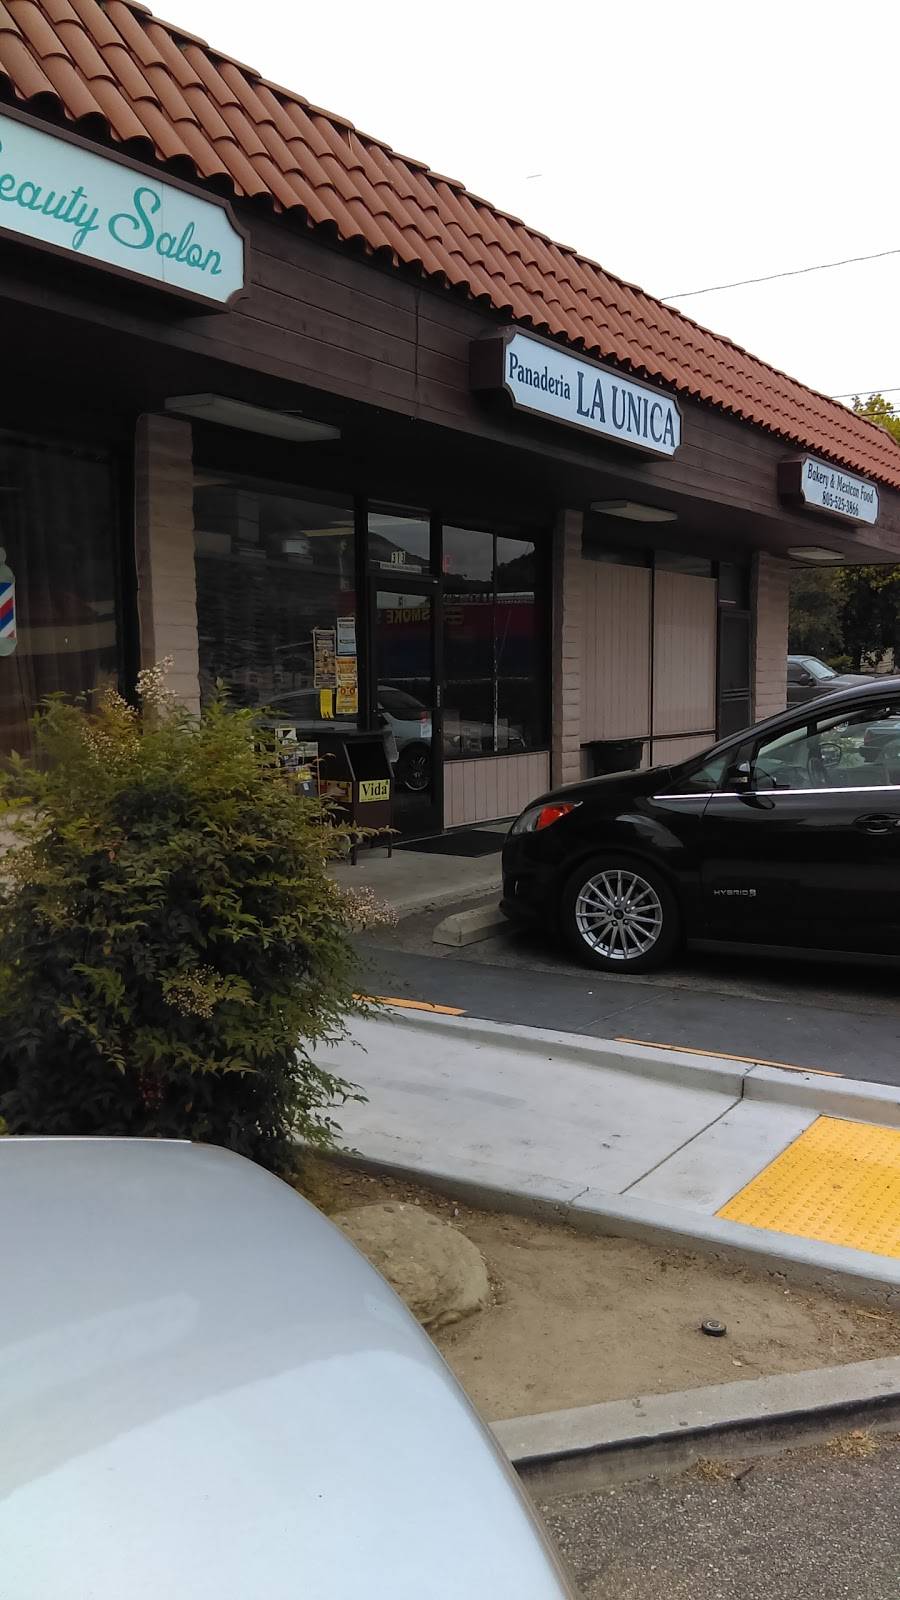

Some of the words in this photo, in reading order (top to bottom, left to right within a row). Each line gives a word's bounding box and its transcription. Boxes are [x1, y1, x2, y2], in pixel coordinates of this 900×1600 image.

[0, 140, 99, 251] eauty
[108, 186, 222, 275] Salon
[509, 352, 571, 401] Panaderia
[576, 370, 606, 424] LA
[611, 385, 676, 448] UNICA
[808, 463, 830, 489] Bakery
[830, 474, 835, 488] &
[836, 475, 859, 498] Mexican
[860, 486, 874, 503] Food
[361, 783, 387, 796] Vida
